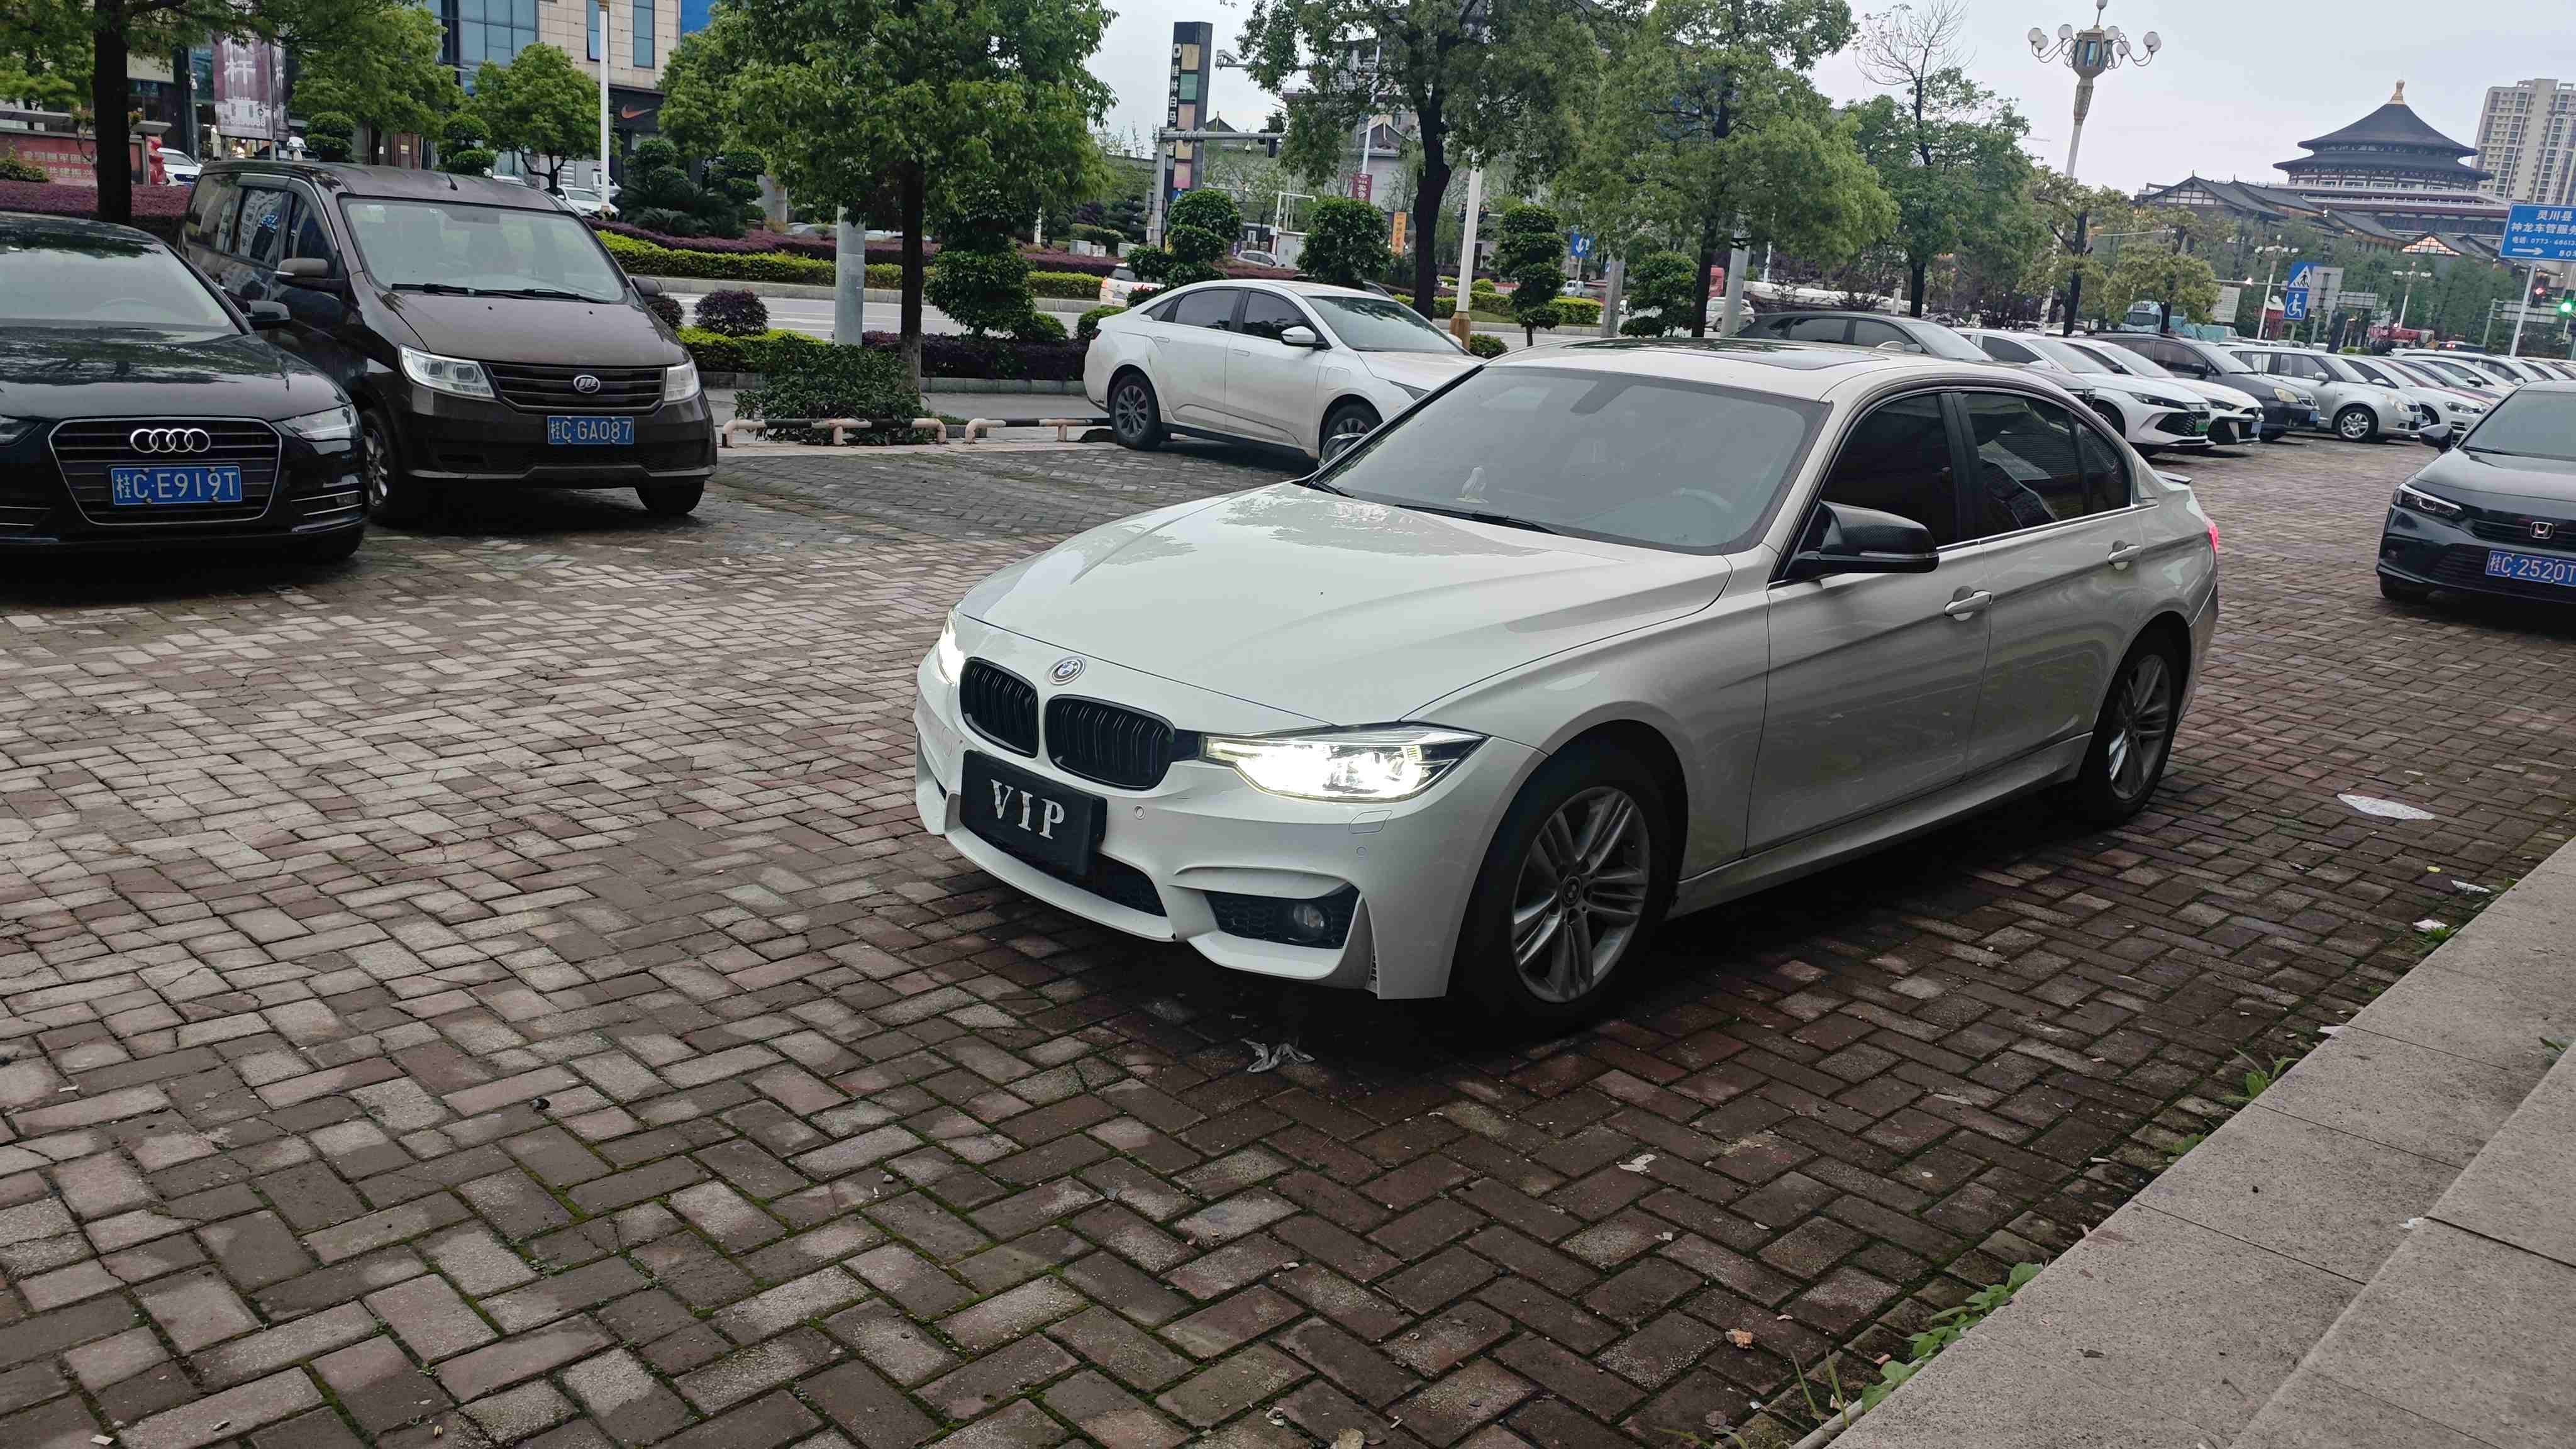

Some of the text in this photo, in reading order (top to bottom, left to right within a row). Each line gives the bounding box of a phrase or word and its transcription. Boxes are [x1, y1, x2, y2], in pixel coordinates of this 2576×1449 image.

[2536, 210, 2573, 222] 灵川县
[991, 779, 1065, 840] VIP
